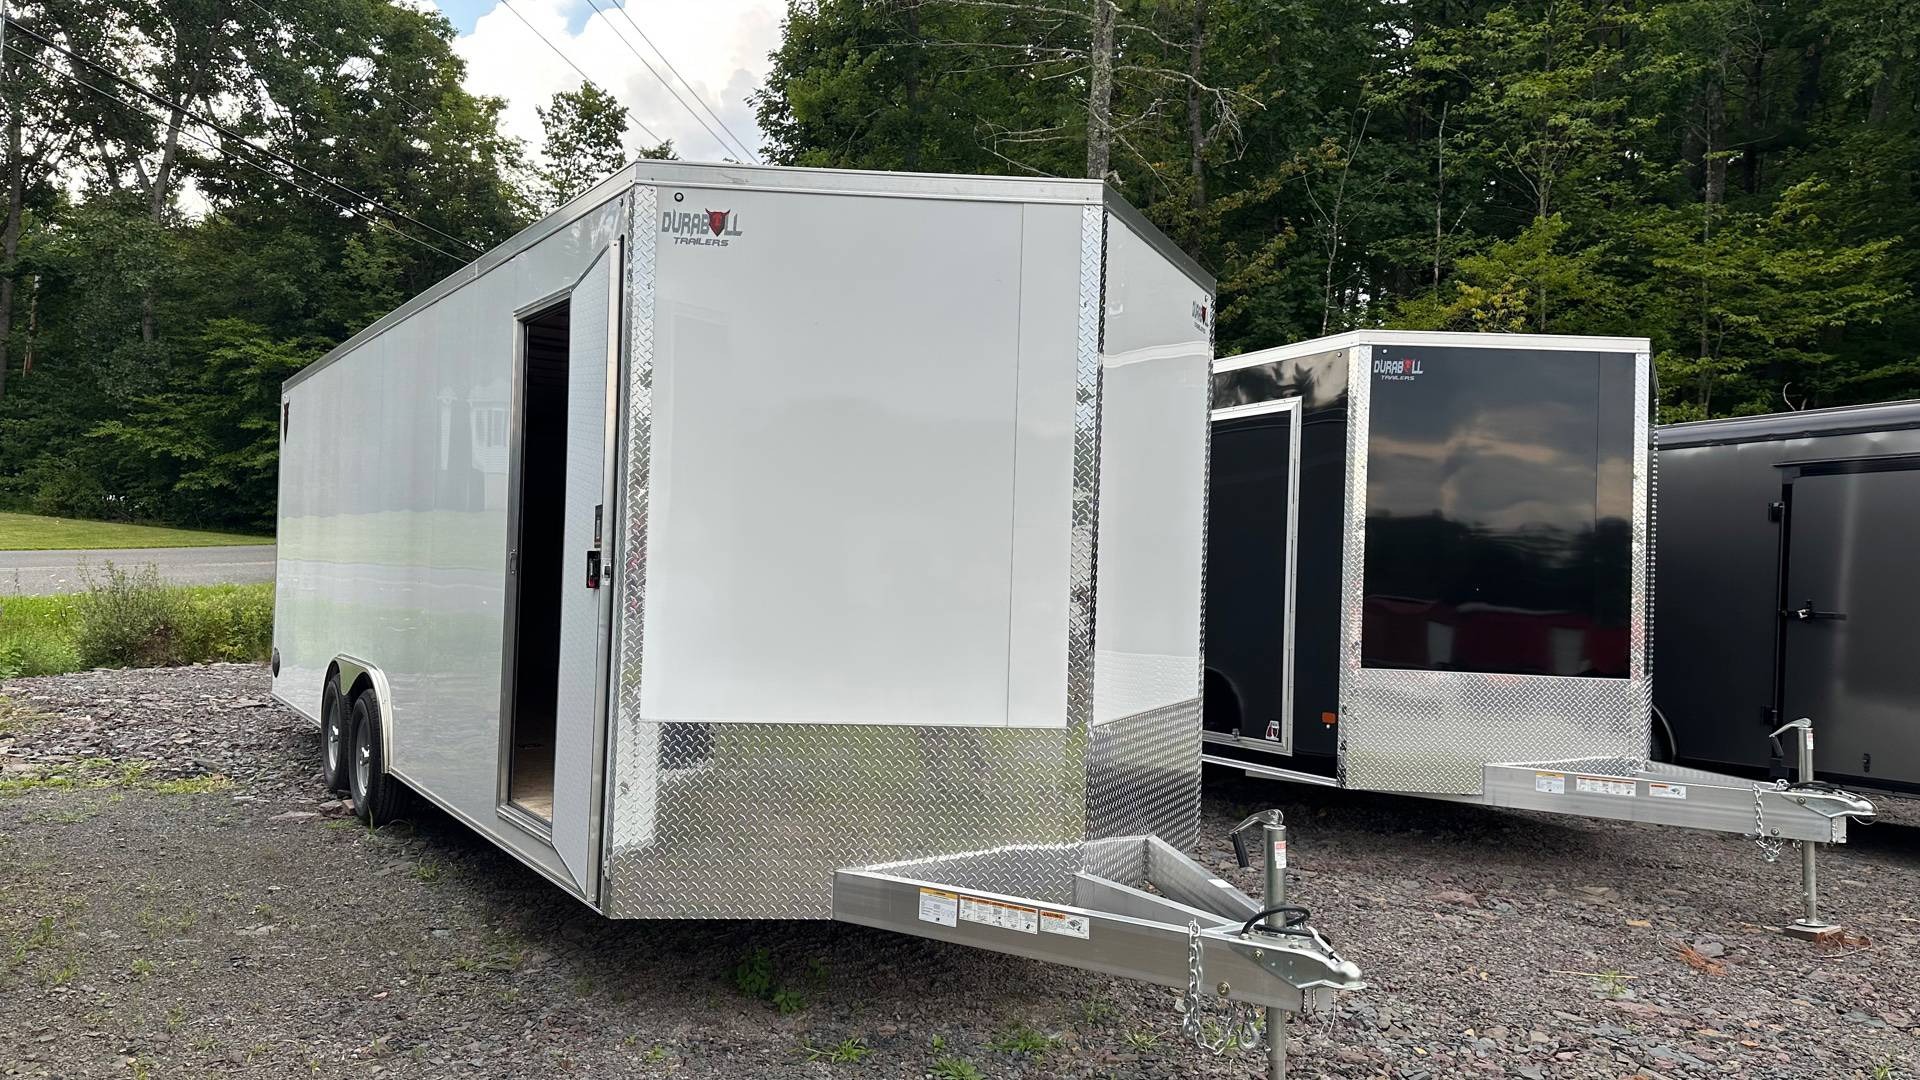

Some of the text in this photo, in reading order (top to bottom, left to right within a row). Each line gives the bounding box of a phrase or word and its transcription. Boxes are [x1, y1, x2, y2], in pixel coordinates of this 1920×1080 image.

[661, 209, 743, 236] DURABLL
[673, 237, 729, 247] TRAILERS
[1373, 359, 1424, 375] DURABLL
